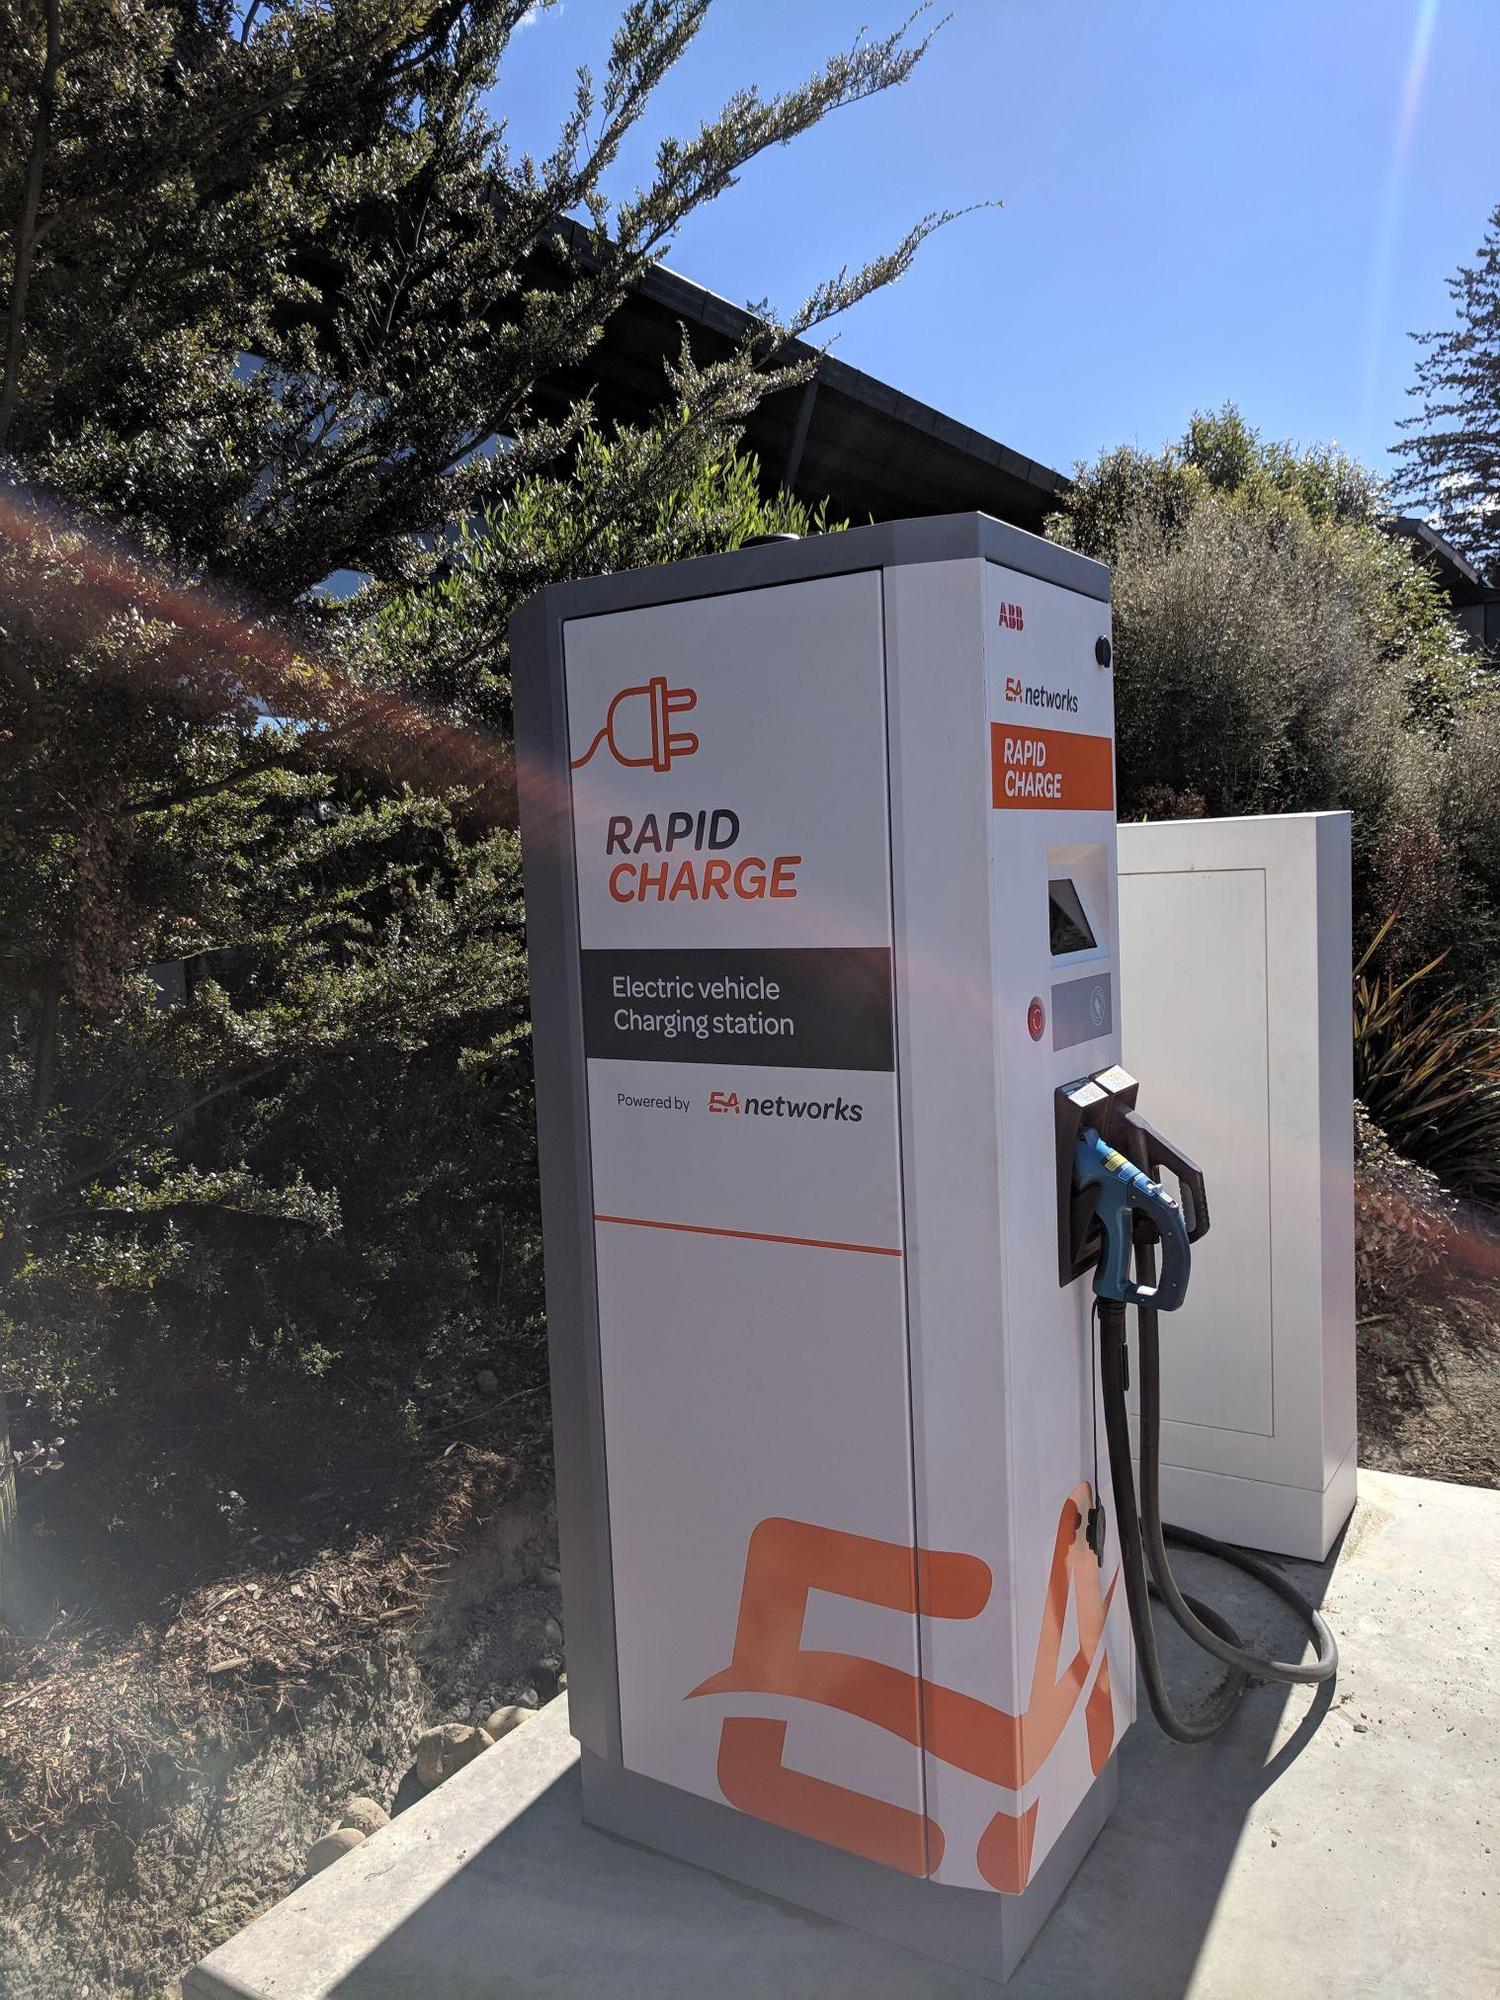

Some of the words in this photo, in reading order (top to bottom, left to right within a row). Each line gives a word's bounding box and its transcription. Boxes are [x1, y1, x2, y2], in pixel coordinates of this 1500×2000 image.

[999, 602, 1024, 631] ABB
[1025, 684, 1078, 713] networks
[1004, 738, 1046, 767] RAPID
[1005, 770, 1062, 798] CHARGE
[606, 809, 740, 855] RAPID
[608, 856, 802, 902] CHARGE
[612, 976, 695, 998] Electric
[698, 976, 780, 1000] vehicle
[614, 1009, 709, 1039] Charging
[712, 1011, 794, 1035] station
[617, 1093, 672, 1110] Powered
[674, 1096, 690, 1113] by
[744, 1095, 864, 1122] networks
